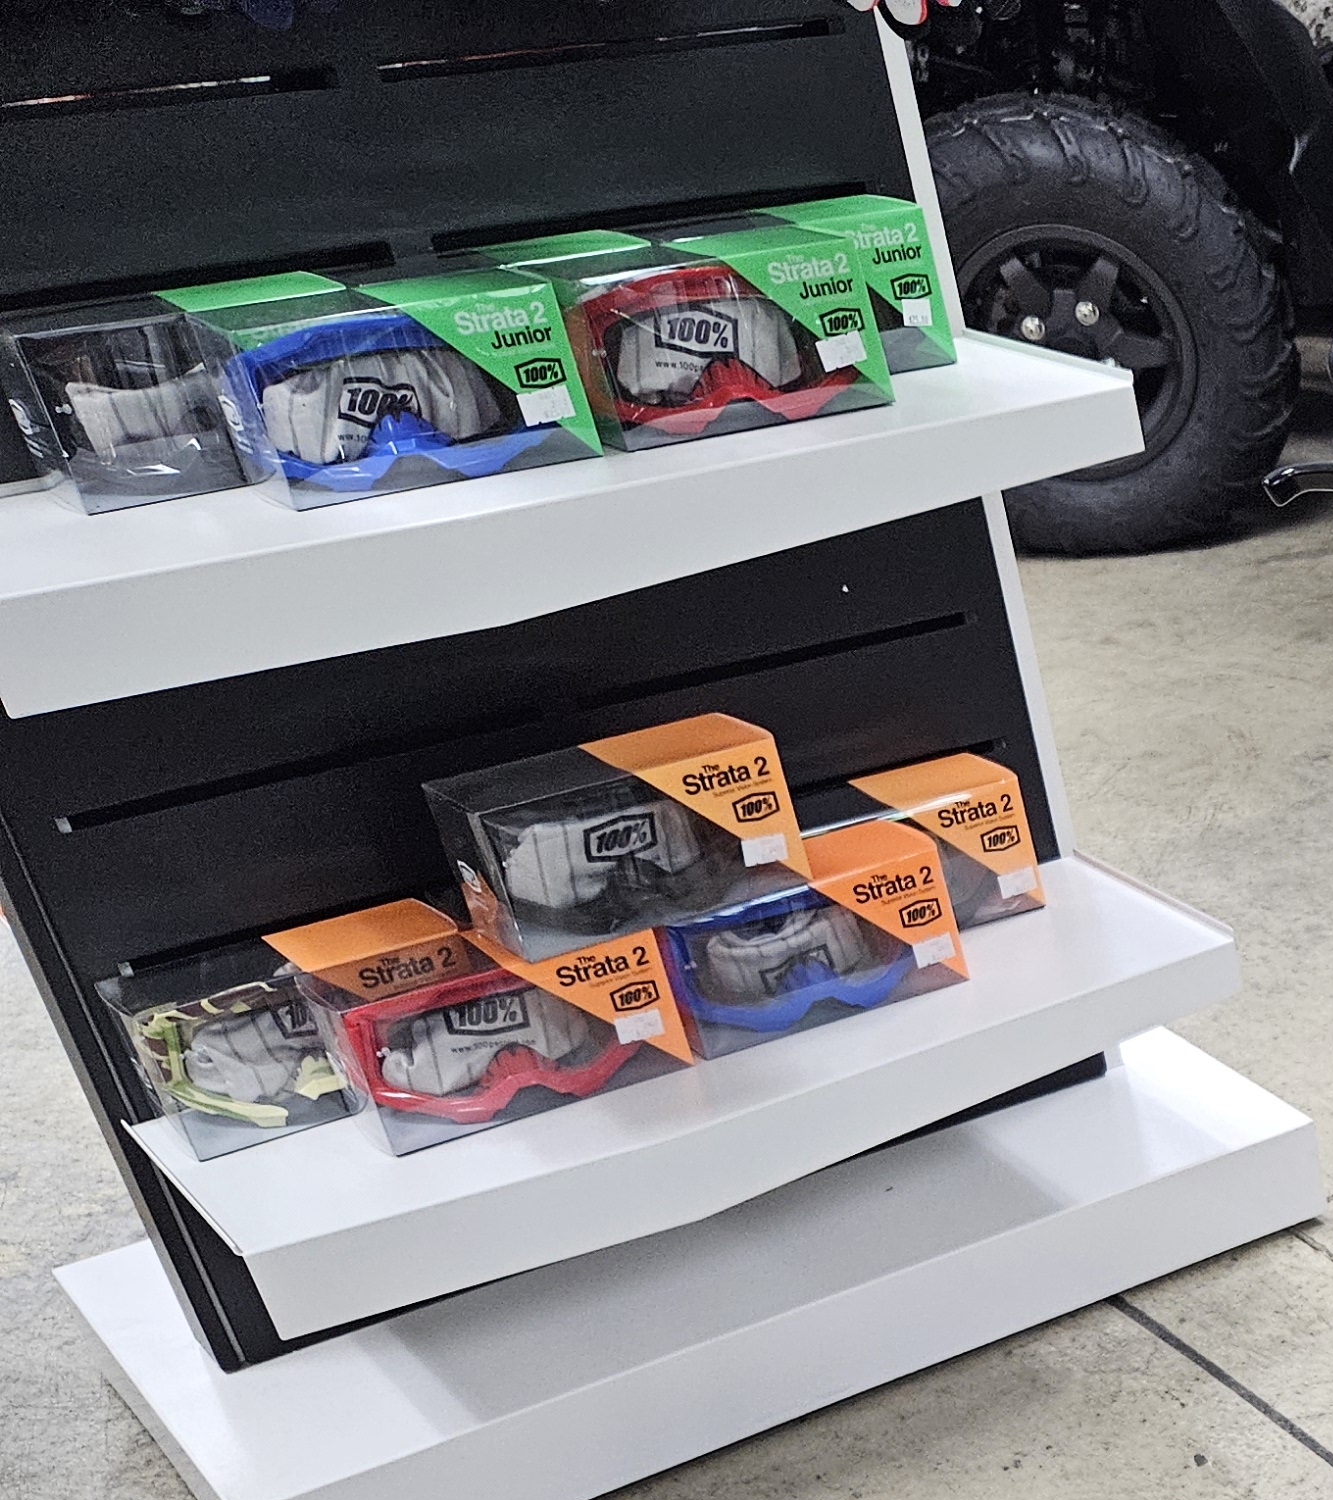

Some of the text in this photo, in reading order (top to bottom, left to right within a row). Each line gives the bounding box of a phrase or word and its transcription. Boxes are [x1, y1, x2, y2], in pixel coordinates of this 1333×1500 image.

[904, 222, 920, 243] 2
[872, 244, 922, 265] Junior
[767, 253, 850, 285] Strata 2
[800, 277, 853, 300] Junior
[898, 278, 926, 297] 100%
[454, 301, 547, 335] Strata 2
[827, 313, 859, 333] 100%
[491, 325, 553, 350] Junior
[666, 316, 730, 349] 100%
[523, 363, 559, 383] 100%
[682, 756, 770, 796] Strata 2
[702, 763, 720, 775] The
[741, 797, 773, 818] 100%
[937, 802, 998, 829] Strata
[1000, 794, 1014, 812] 2
[955, 799, 970, 809] The
[595, 819, 648, 855] 100%
[986, 831, 1016, 849] 100%
[852, 876, 917, 905] Strata
[919, 866, 935, 885] 2
[871, 874, 889, 884] The
[905, 901, 937, 924] 100%
[358, 956, 436, 990] Strata
[438, 947, 456, 968] 2
[555, 956, 630, 987] Strata
[632, 946, 651, 967] 2
[577, 955, 597, 966] The
[619, 985, 654, 1007] 100%
[453, 996, 518, 1027] 100%
